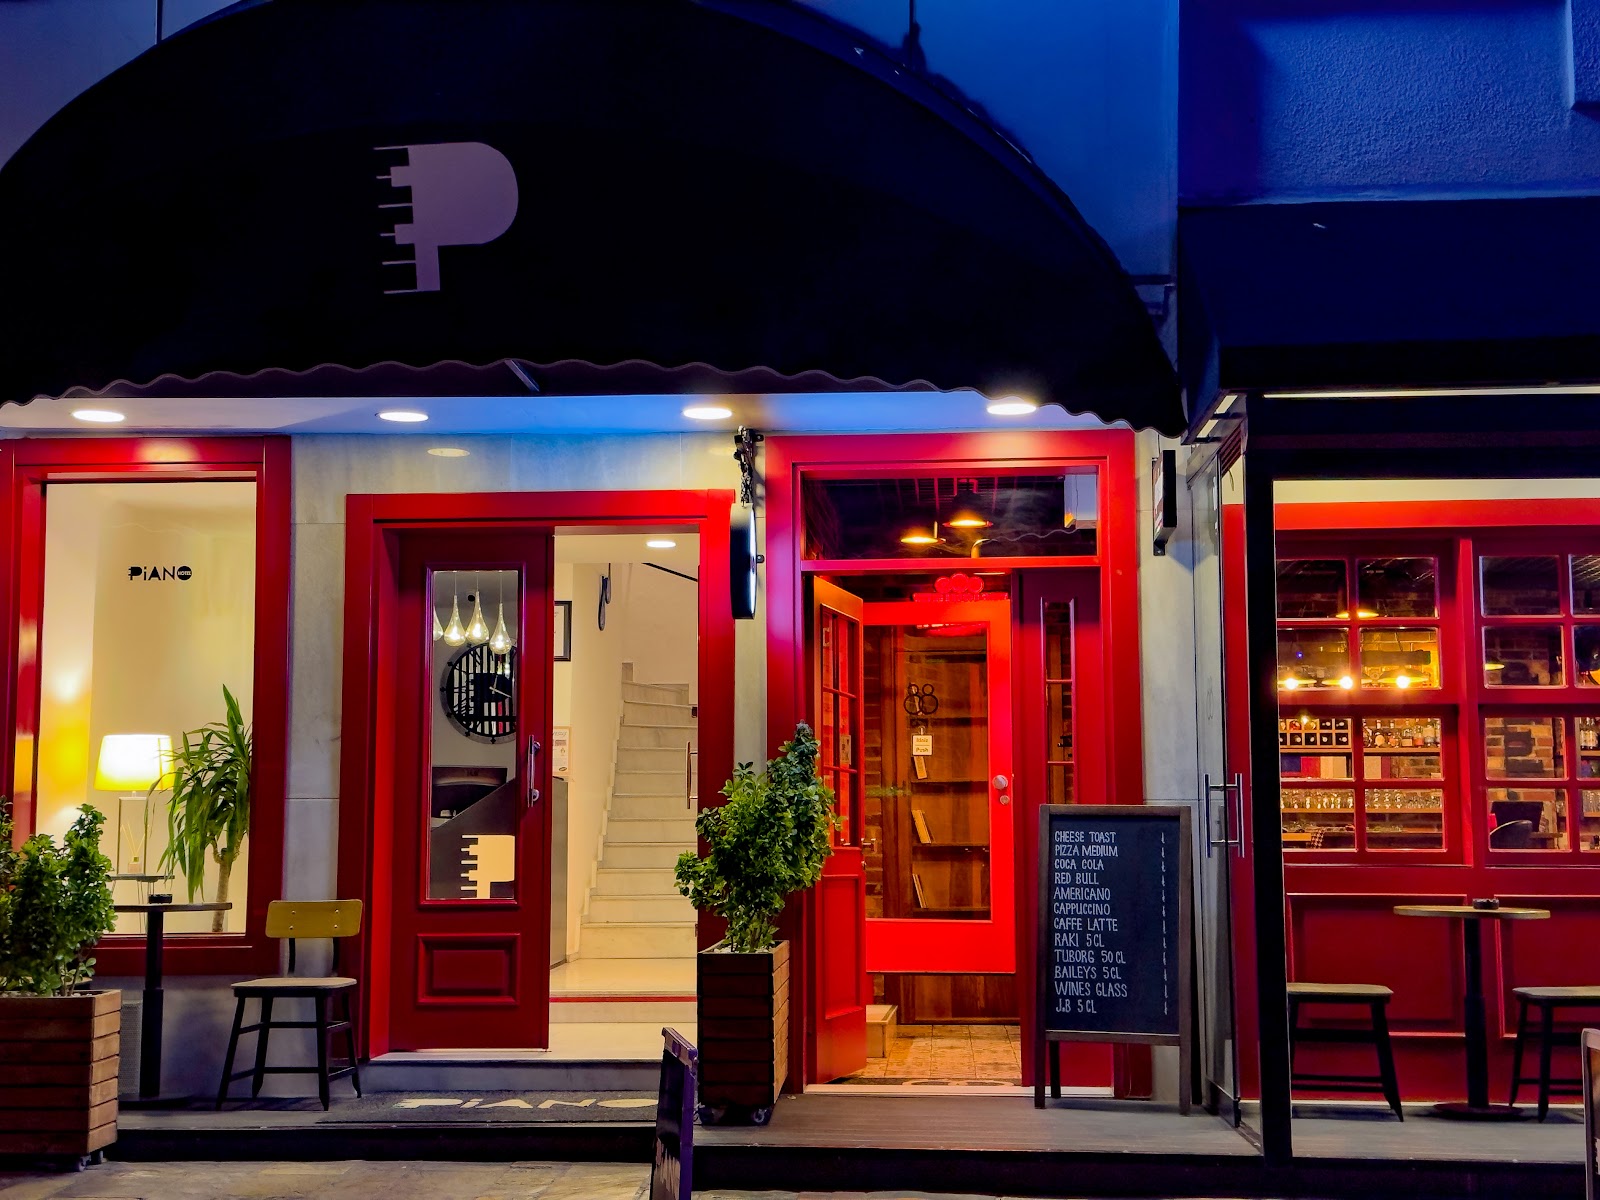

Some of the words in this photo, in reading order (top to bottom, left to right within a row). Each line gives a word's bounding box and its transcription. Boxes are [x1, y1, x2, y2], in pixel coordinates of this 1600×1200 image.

[1054, 830, 1085, 843] CHEESE
[1088, 831, 1117, 843] TOAST
[1054, 844, 1080, 856] PIZZA
[1081, 845, 1118, 857] MEDIUM
[1054, 859, 1077, 870] COCA
[1081, 859, 1104, 870] COLA
[1054, 872, 1071, 884] RED
[1075, 872, 1099, 885] BULL
[1053, 887, 1111, 901] AMERICANO
[1053, 902, 1111, 915] CAPPUCCINO
[1053, 917, 1082, 931] CAFFE
[1087, 918, 1118, 931] LATTE
[1054, 932, 1079, 947] RAKI
[1054, 949, 1095, 963] TUBORG
[1054, 965, 1097, 979] BAILEYS
[1054, 981, 1091, 996] WINES
[1095, 982, 1128, 997] GLASS
